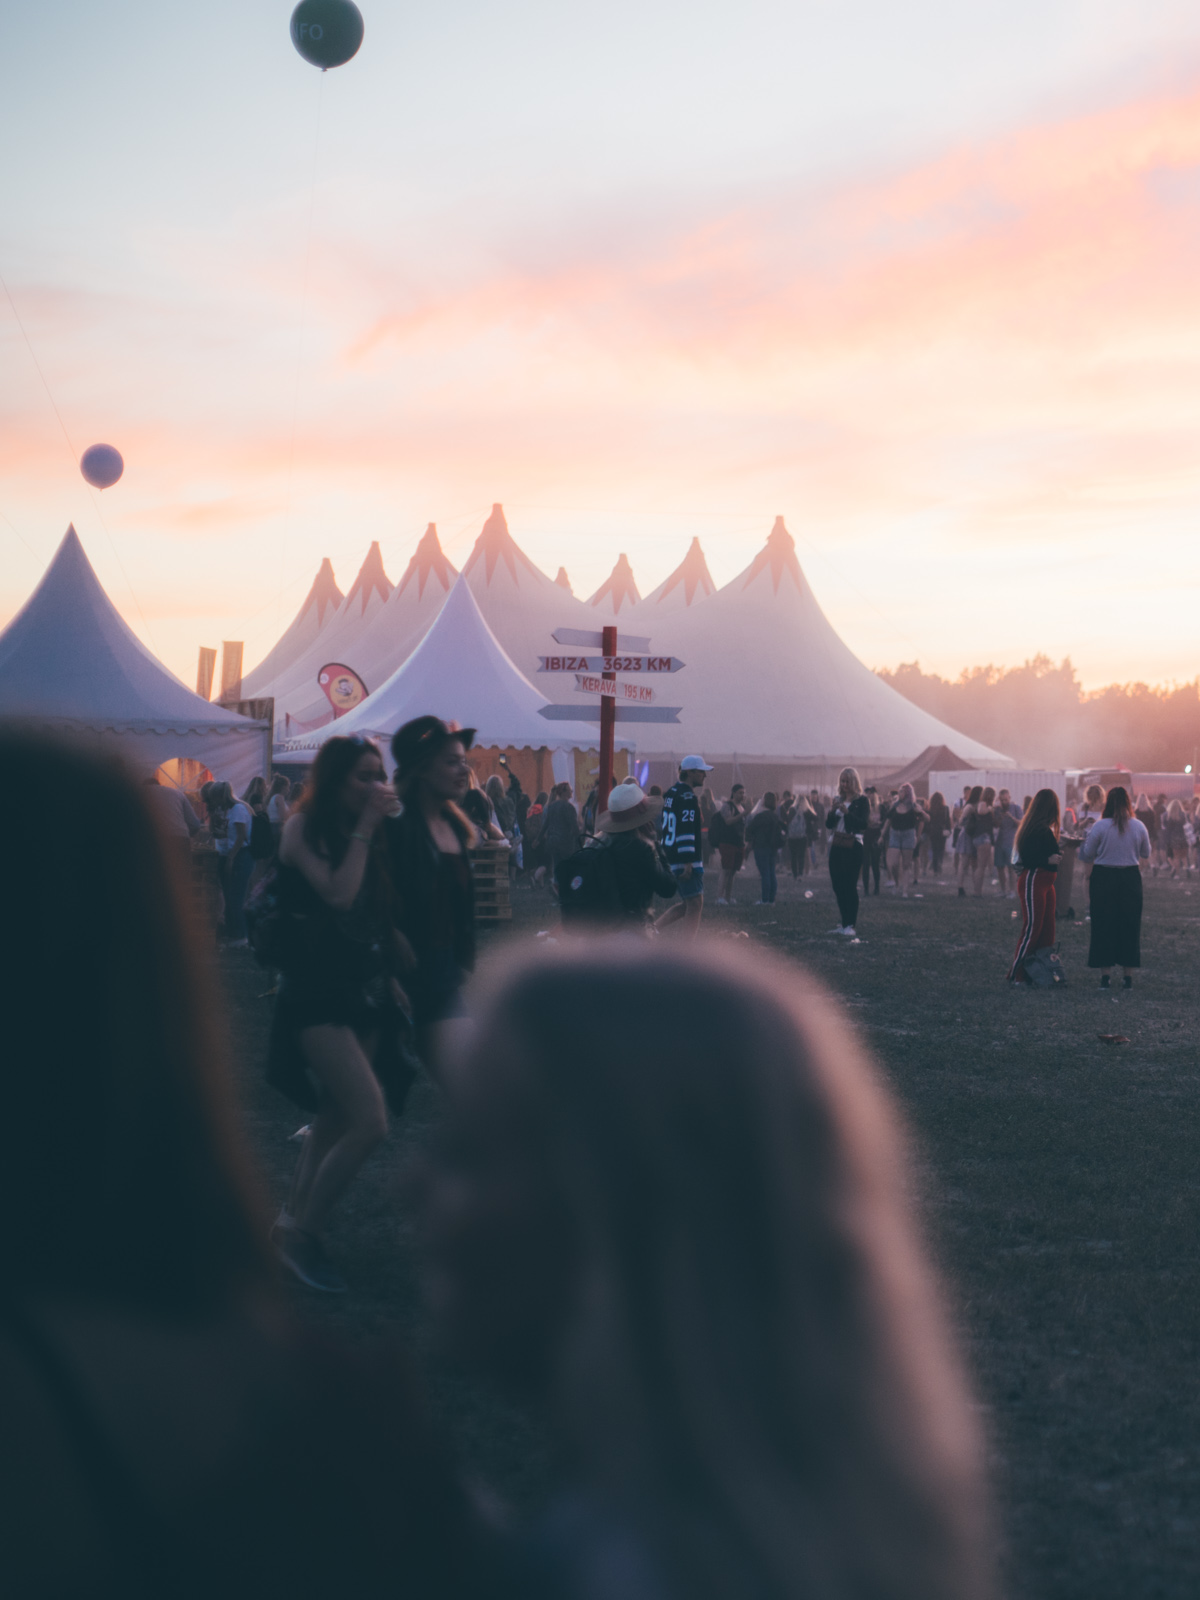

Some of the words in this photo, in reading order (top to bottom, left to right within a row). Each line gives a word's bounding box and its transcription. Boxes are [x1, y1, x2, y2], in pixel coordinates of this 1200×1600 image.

[545, 656, 589, 671] IBIZA
[603, 657, 642, 671] 3623
[647, 657, 672, 671] KM
[582, 676, 617, 695] KERAVA
[624, 683, 638, 699] 195
[639, 687, 652, 701] KM
[681, 809, 696, 822] 29
